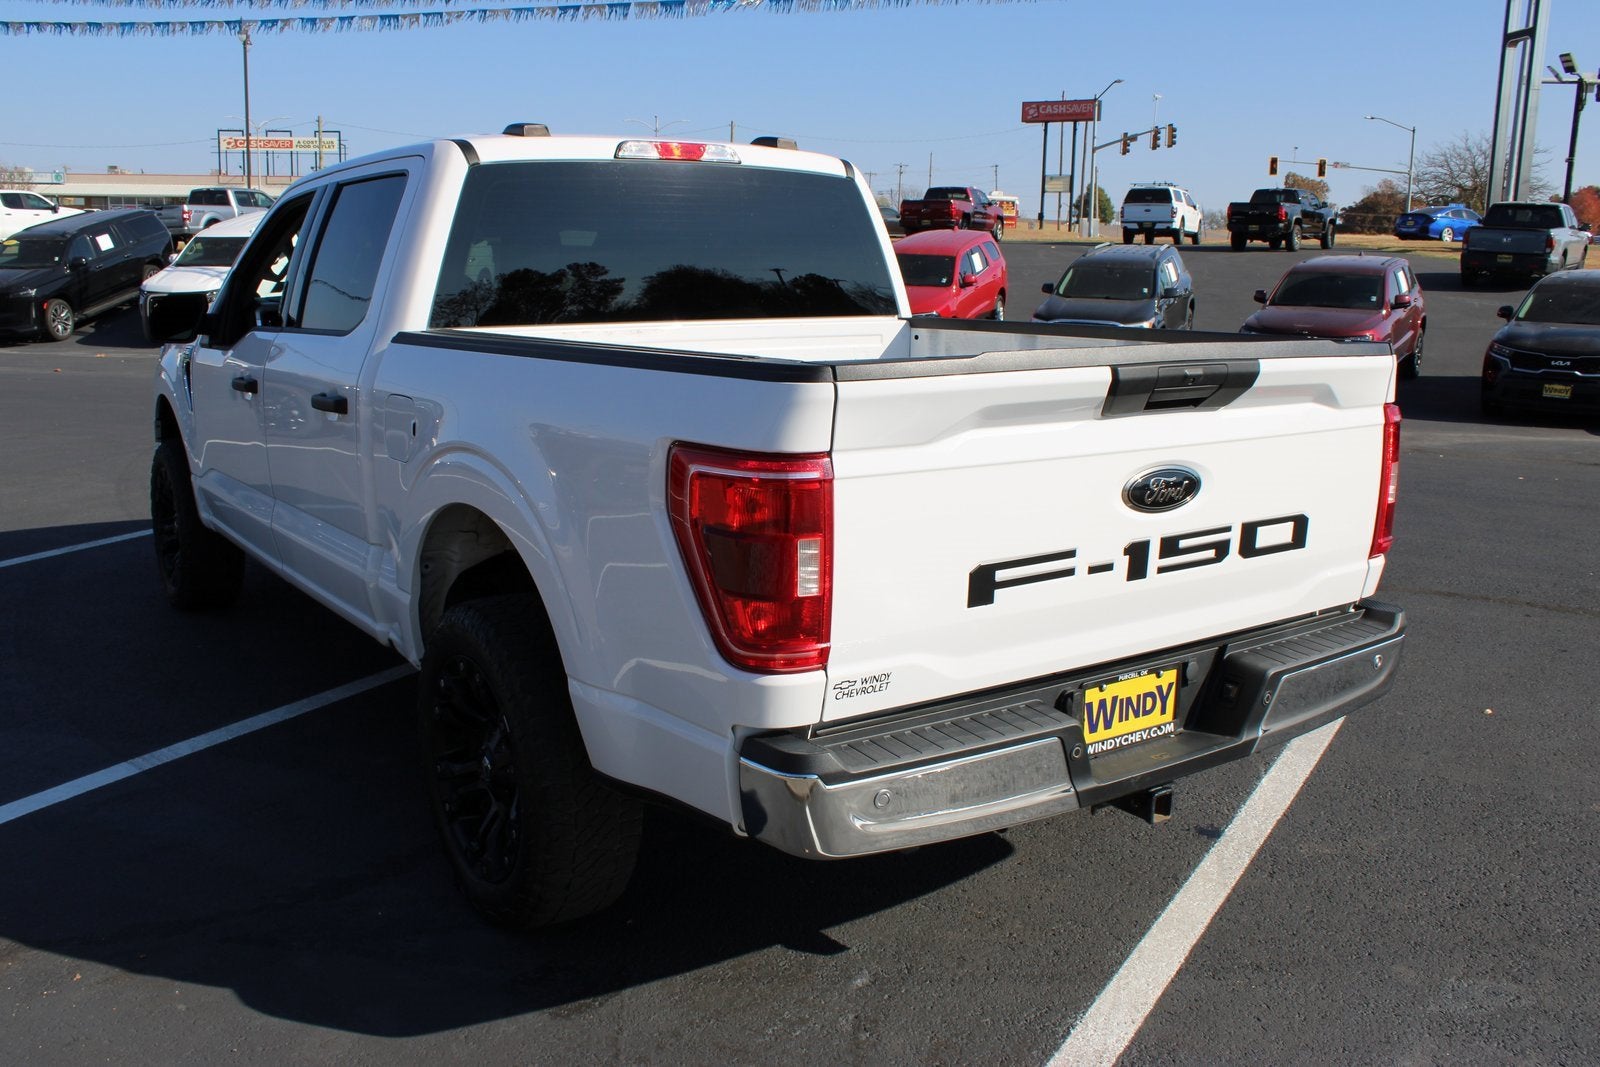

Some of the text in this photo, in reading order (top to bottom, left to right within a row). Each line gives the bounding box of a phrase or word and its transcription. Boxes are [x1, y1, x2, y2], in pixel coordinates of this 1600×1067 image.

[1039, 103, 1093, 114] CASHSAVER
[1145, 476, 1189, 504] Ford
[967, 512, 1310, 608] F-150
[861, 672, 892, 685] WINDY
[835, 682, 891, 700] CHEVROLET
[1085, 682, 1175, 734] WINDY
